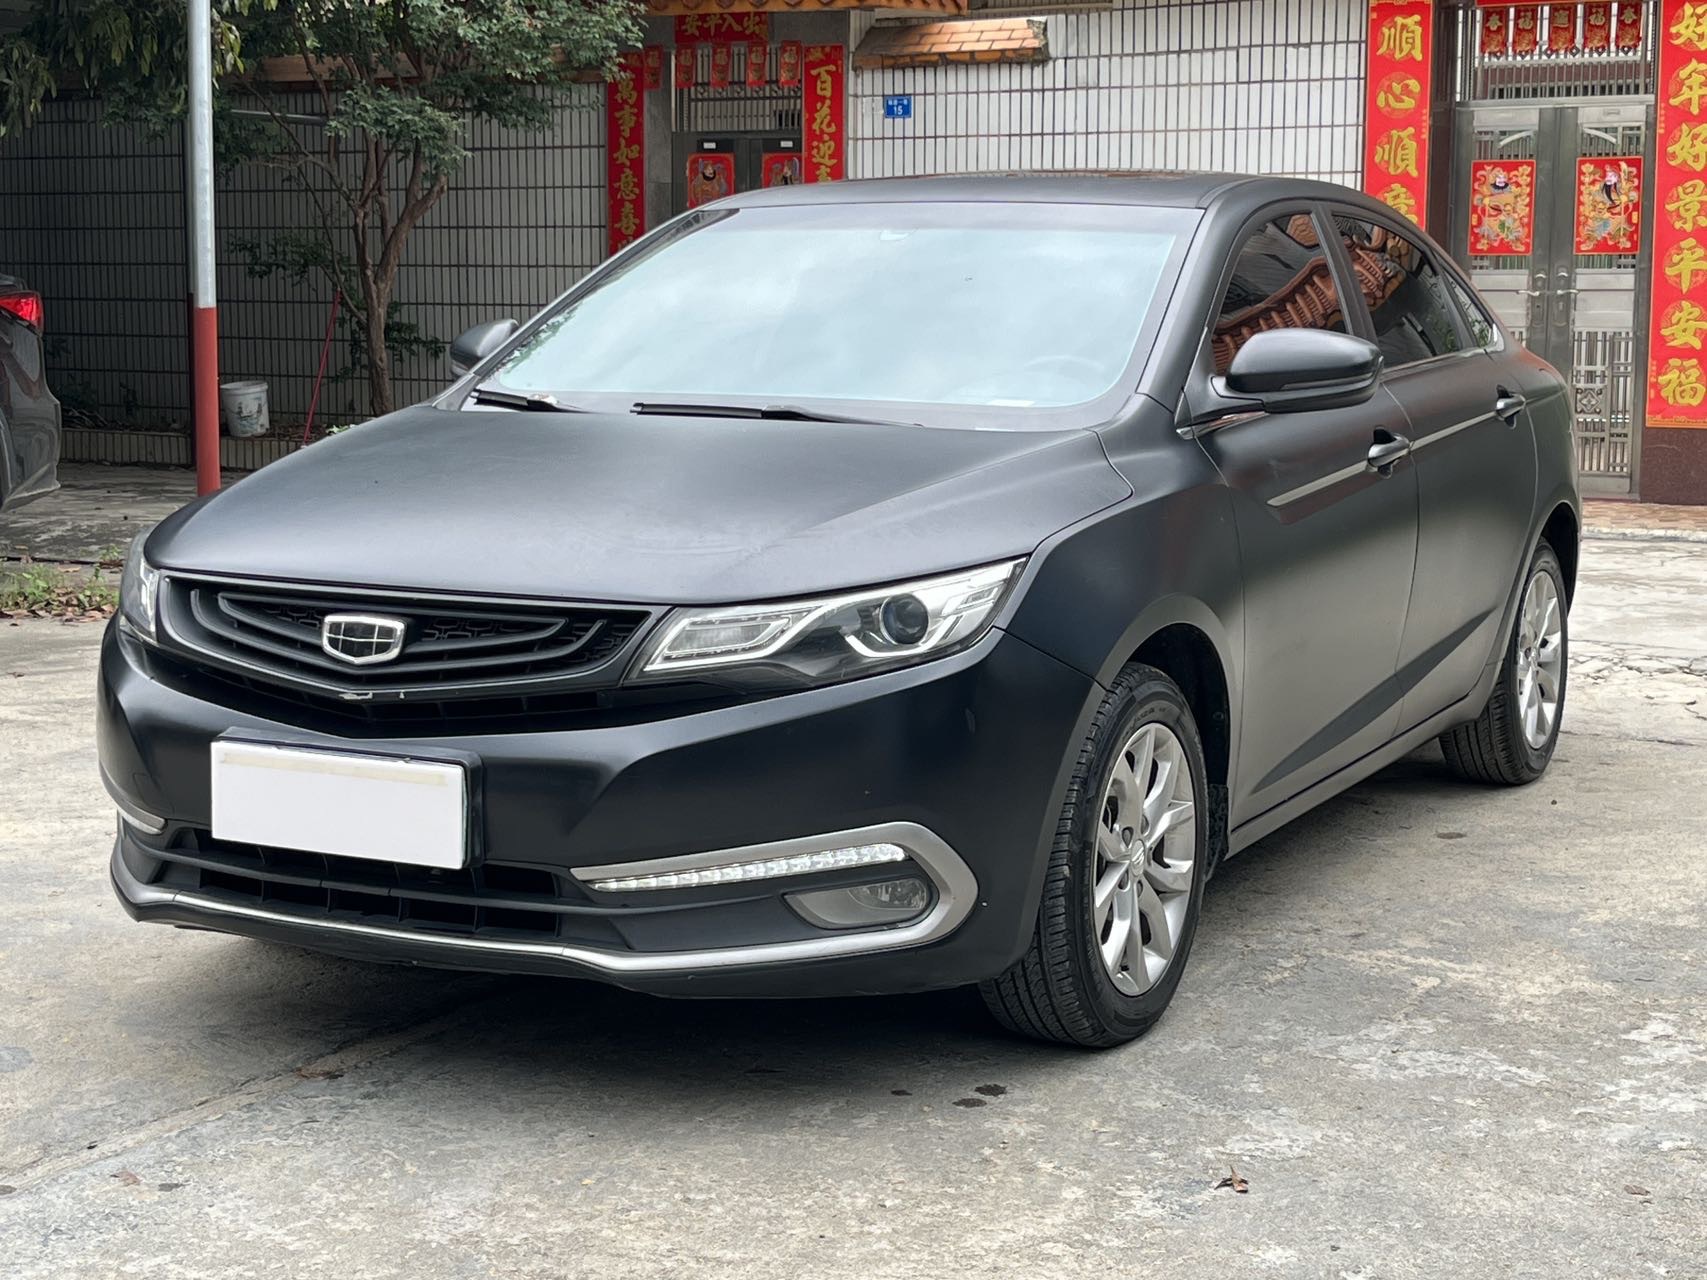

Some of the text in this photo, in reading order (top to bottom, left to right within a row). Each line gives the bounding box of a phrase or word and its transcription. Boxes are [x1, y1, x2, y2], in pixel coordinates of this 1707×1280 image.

[614, 77, 640, 250] 萬事如意喜
[893, 105, 903, 115] 15
[1658, 2, 1707, 407] 好年好景平安福
